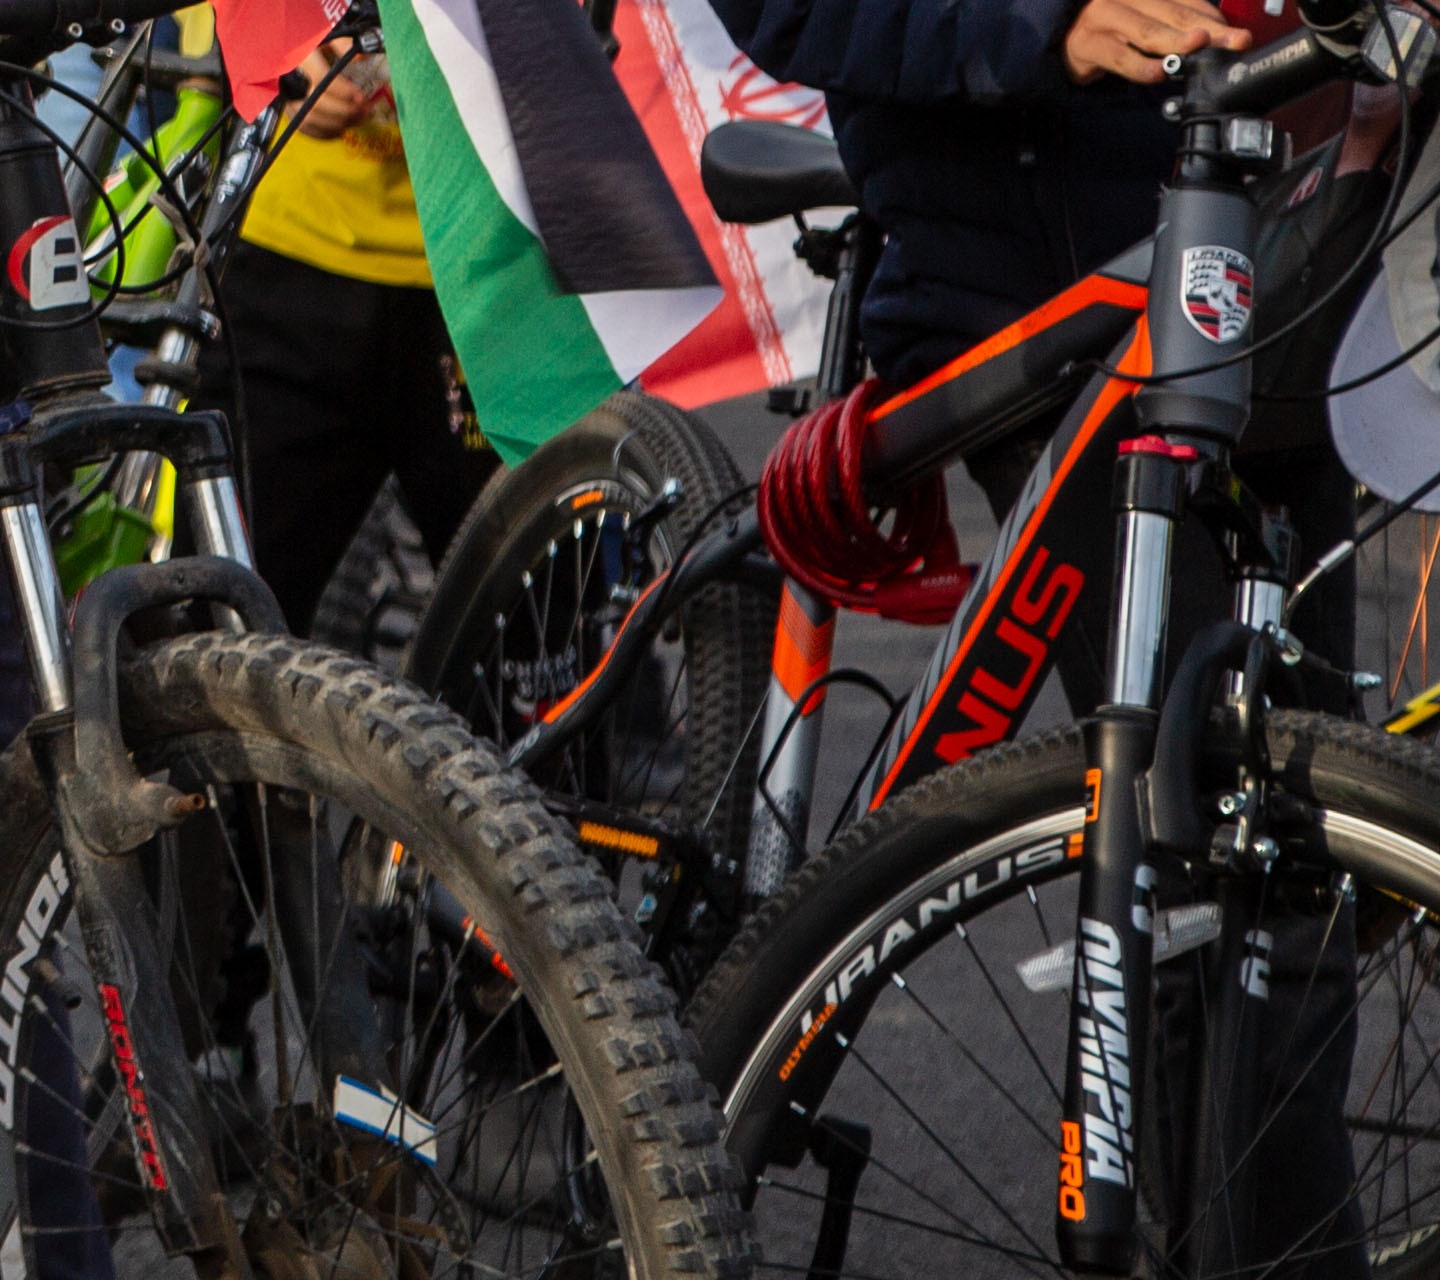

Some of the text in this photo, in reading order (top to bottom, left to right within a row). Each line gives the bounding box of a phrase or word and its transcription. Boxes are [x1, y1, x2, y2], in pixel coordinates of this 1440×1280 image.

[935, 545, 1086, 765] NUS
[799, 840, 1068, 1036] URANUS
[1080, 916, 1135, 1190] OLYMPIA
[1058, 1120, 1086, 1222] PRO
